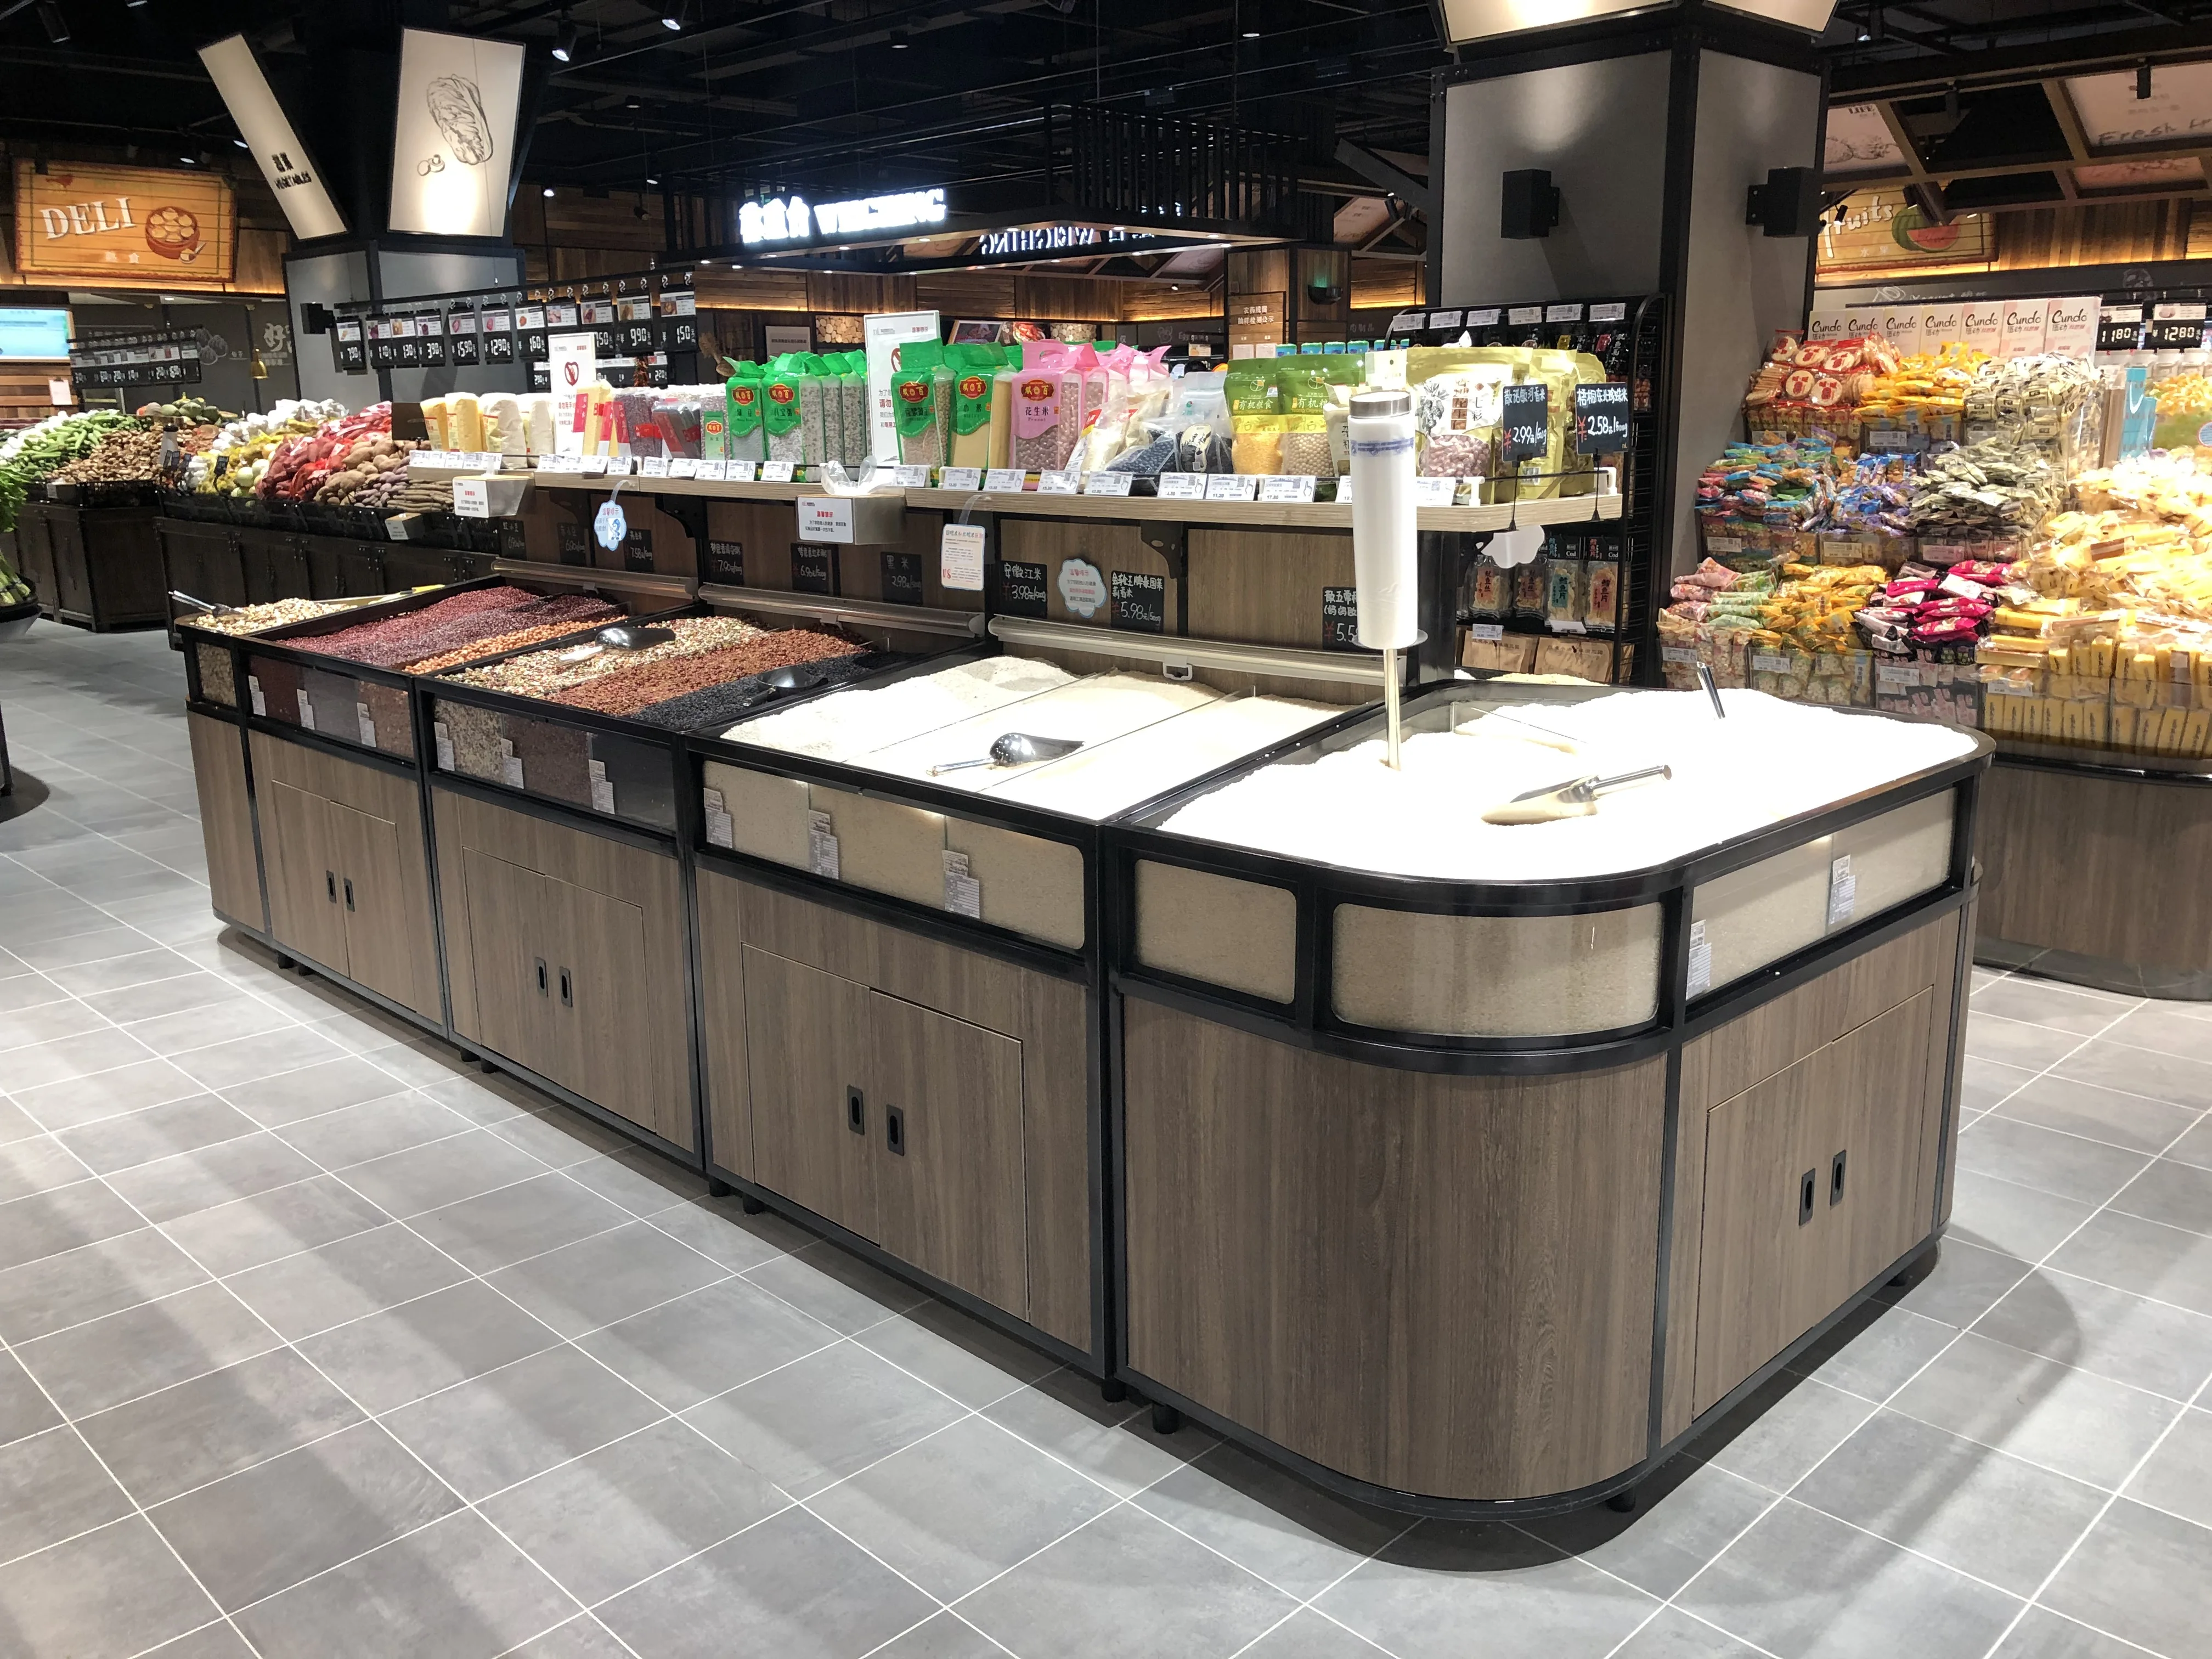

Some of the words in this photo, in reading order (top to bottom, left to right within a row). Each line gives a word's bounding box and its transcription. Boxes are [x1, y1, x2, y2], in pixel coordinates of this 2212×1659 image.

[40, 197, 137, 240] DELI
[1886, 315, 1917, 330] Cundo
[1925, 314, 1957, 329] Cundo
[1965, 312, 1999, 328] Cundo
[2007, 310, 2042, 326] Cundo
[2051, 308, 2088, 324] Cundo
[1812, 319, 1842, 333] Cundo
[1848, 318, 1878, 332] Cundo
[1238, 399, 1273, 410] 有机粮食
[1576, 387, 1628, 407] 梧桐东北珍珠米
[1025, 406, 1049, 416] 花生米
[886, 555, 909, 570] 黑米
